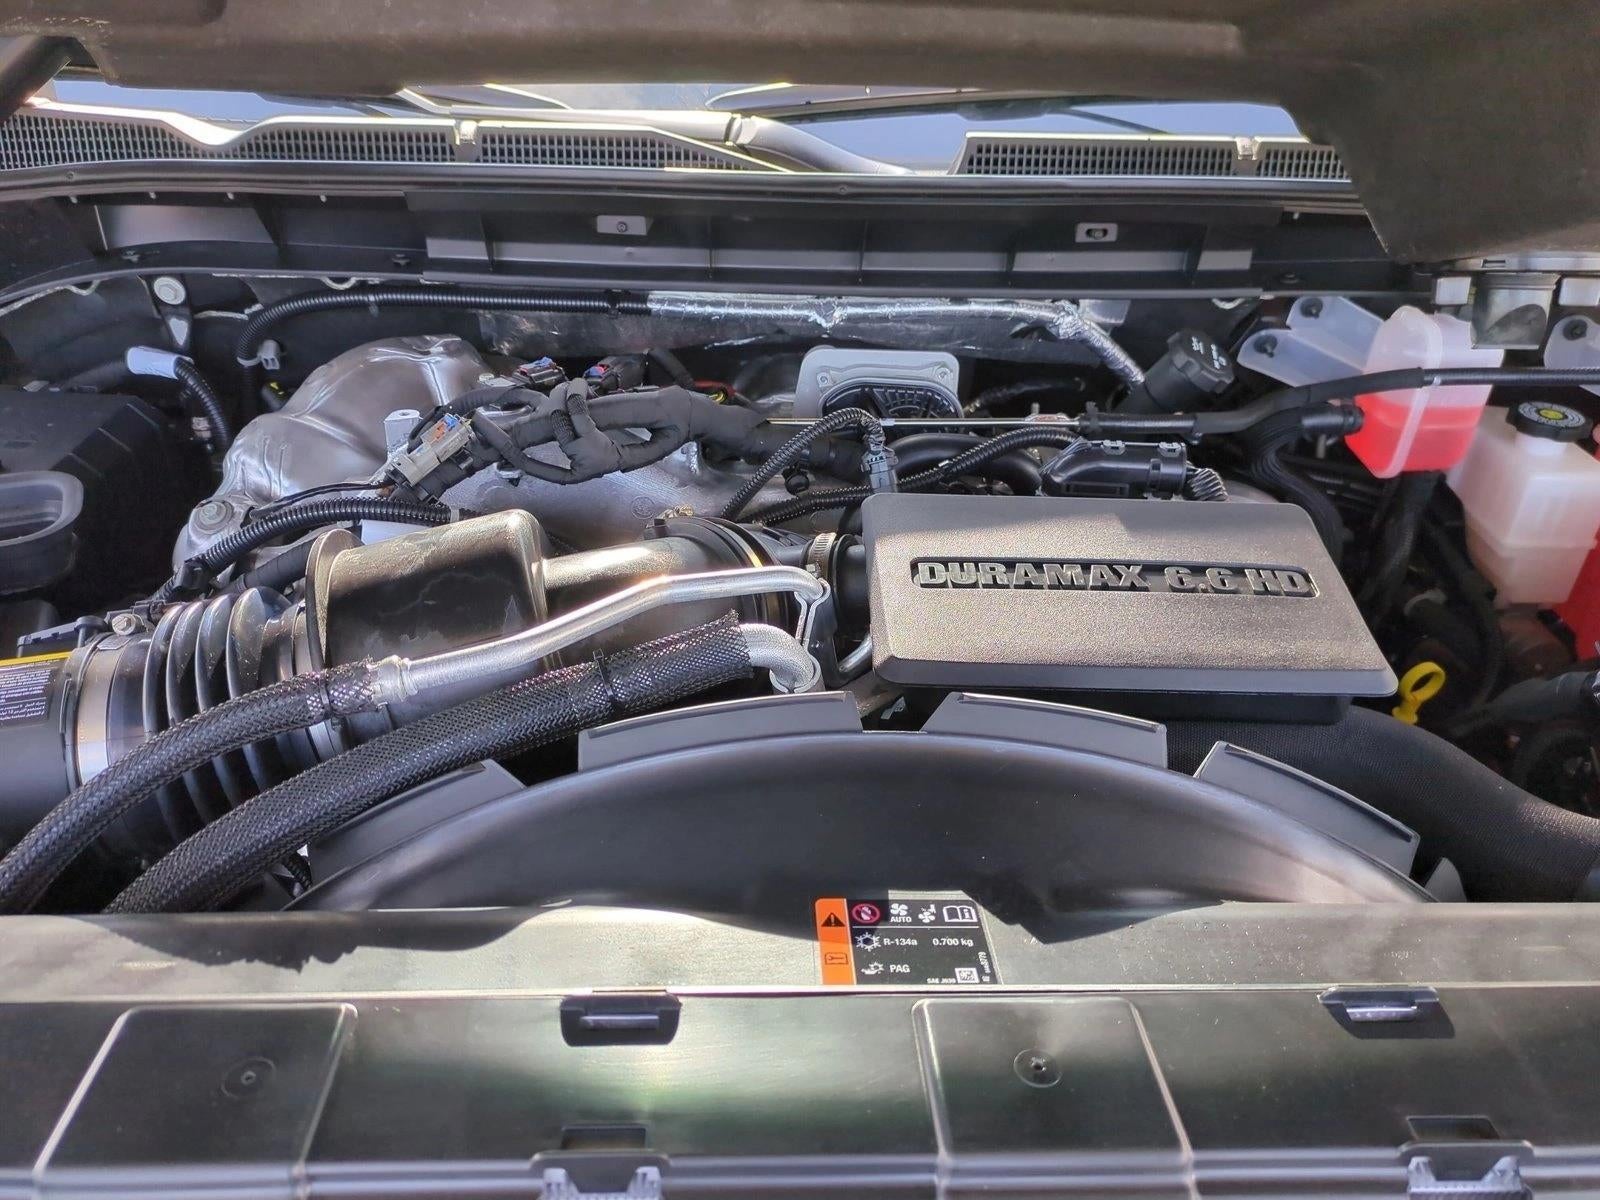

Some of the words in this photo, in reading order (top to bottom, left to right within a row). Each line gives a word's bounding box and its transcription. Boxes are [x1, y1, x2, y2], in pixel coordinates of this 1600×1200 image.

[918, 562, 1149, 590] DURAMAX
[1164, 566, 1237, 593] 6.6
[1244, 568, 1312, 596] HD
[883, 938, 918, 946] R-134a
[932, 938, 959, 946] 0.700
[960, 938, 974, 947] kg
[889, 964, 911, 973] PAG
